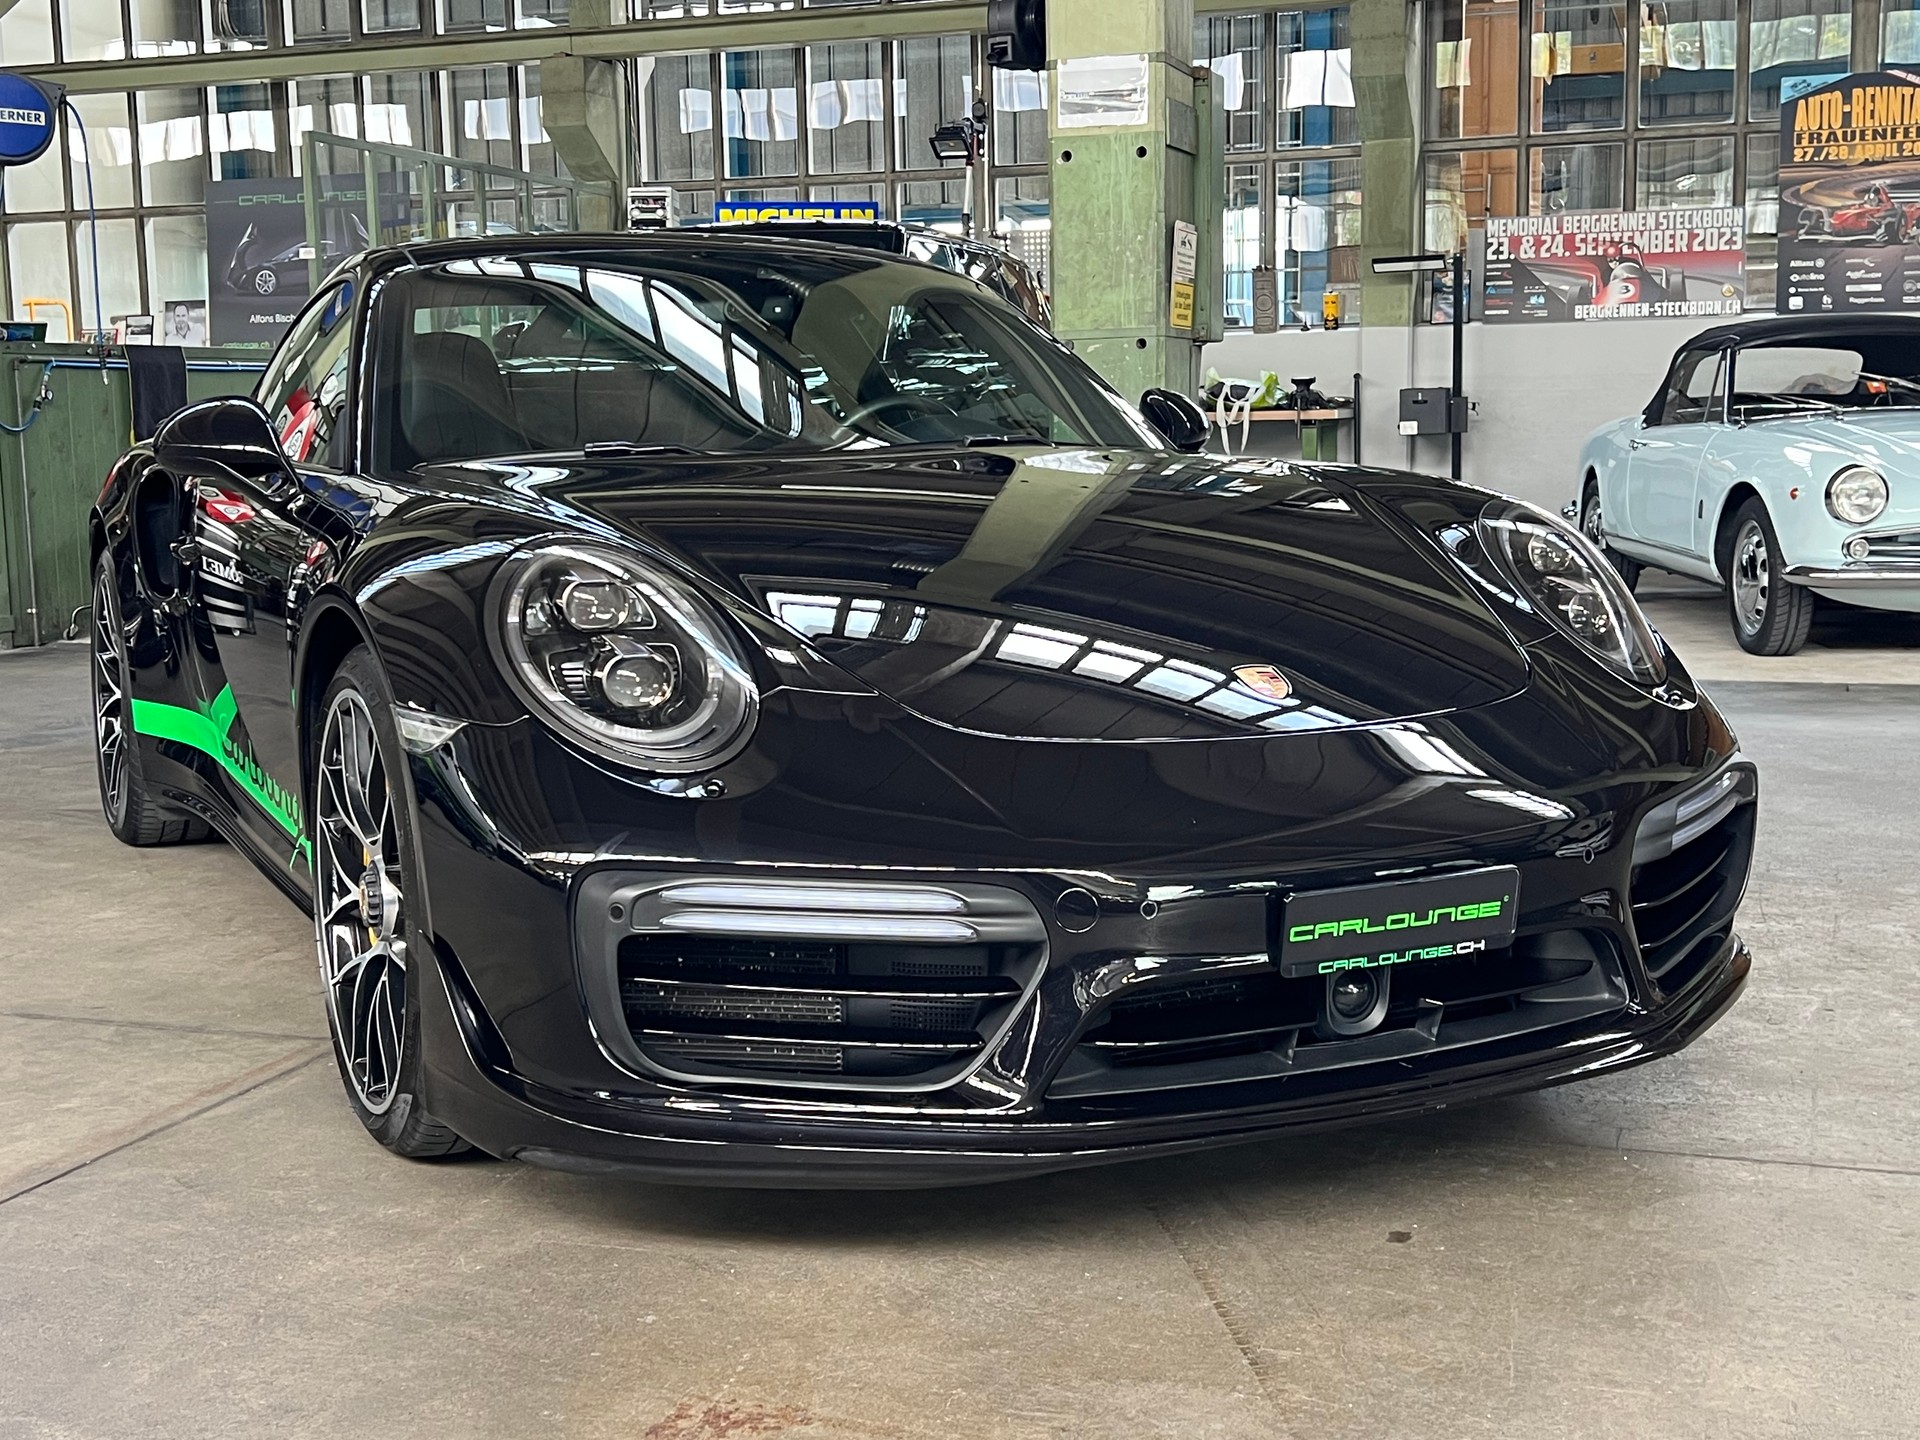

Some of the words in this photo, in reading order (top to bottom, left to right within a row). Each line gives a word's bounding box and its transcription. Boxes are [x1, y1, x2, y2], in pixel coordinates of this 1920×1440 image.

[1487, 219, 1559, 237] MEMORIAL
[1563, 212, 1656, 234] BERGRENNEN
[1659, 209, 1744, 229] STECKBORN
[1486, 236, 1516, 261] 23.
[1520, 236, 1537, 259] &
[1540, 234, 1570, 258] 24.
[1692, 228, 1744, 250] 2023
[249, 314, 274, 324] Alfons
[1574, 299, 1741, 320] BERGRENNEN-STECKBORN.CH
[1289, 901, 1502, 943] CARLOUNGE
[1318, 939, 1485, 974] CARLOUNGE.CH
